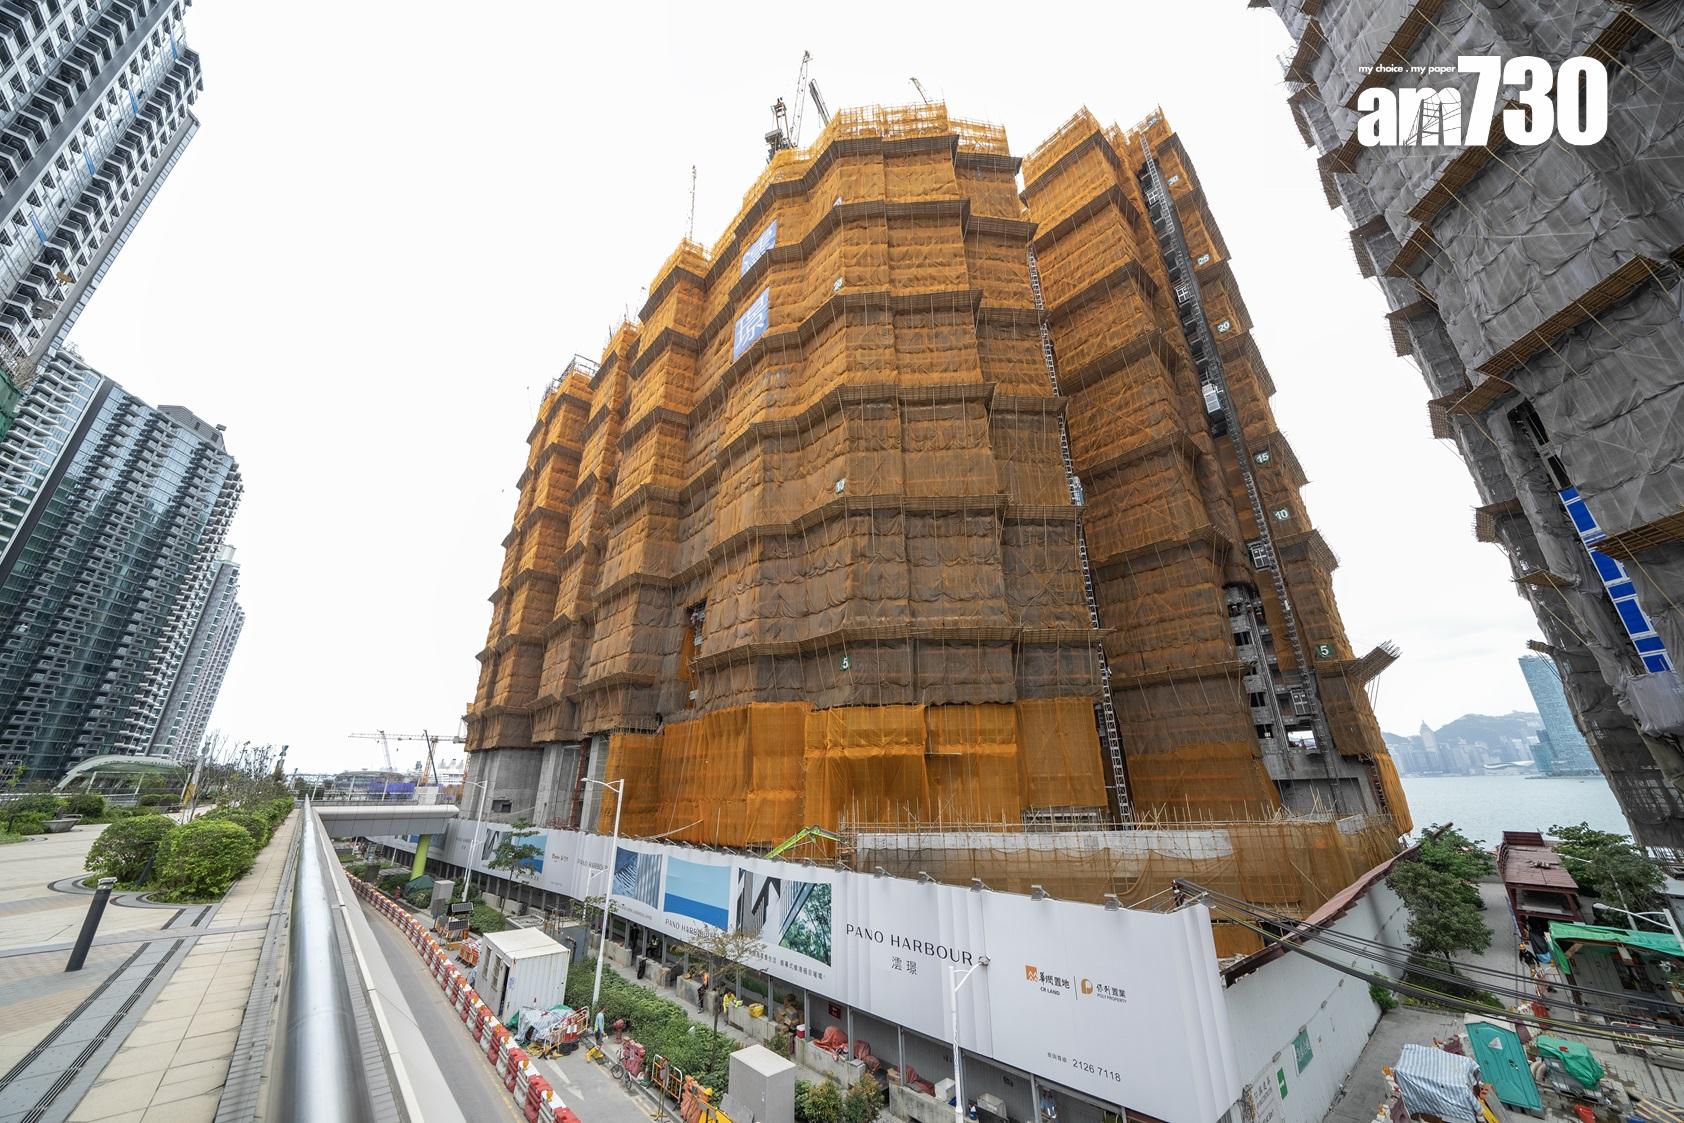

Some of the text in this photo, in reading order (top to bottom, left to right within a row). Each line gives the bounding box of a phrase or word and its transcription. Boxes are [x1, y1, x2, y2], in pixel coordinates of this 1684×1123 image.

[1217, 321, 1230, 332] 20
[1256, 452, 1269, 463] 15
[1273, 509, 1288, 520] 10
[1320, 645, 1329, 655] 5
[842, 657, 849, 669] 5
[665, 918, 680, 930] PANO
[846, 923, 973, 966] PANO HARBOUR
[1073, 1058, 1121, 1082] 2126 7118
